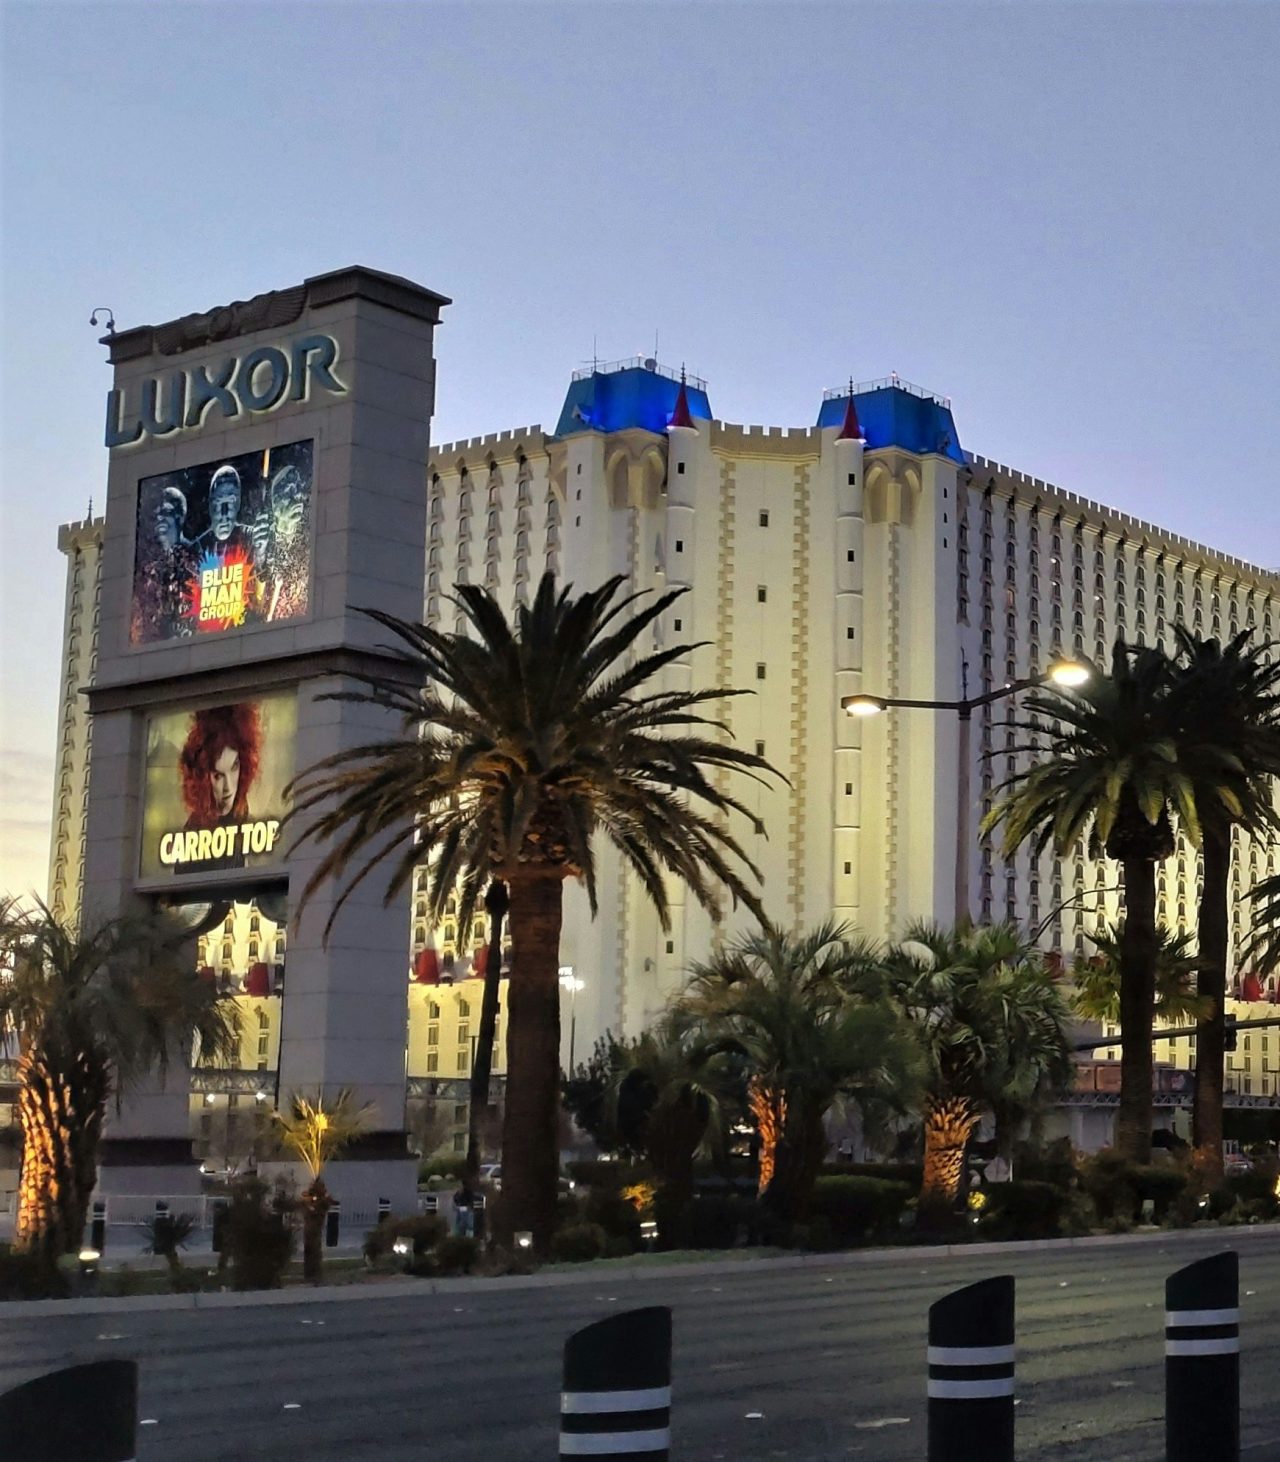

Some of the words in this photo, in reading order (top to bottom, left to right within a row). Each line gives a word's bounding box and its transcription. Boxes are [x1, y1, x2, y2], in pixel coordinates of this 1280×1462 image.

[105, 334, 349, 448] LUXOR
[202, 563, 244, 588] BLUE
[200, 581, 243, 608] MAN
[199, 602, 243, 621] GROUP
[160, 825, 239, 865] CARROT
[241, 820, 280, 855] TOP
